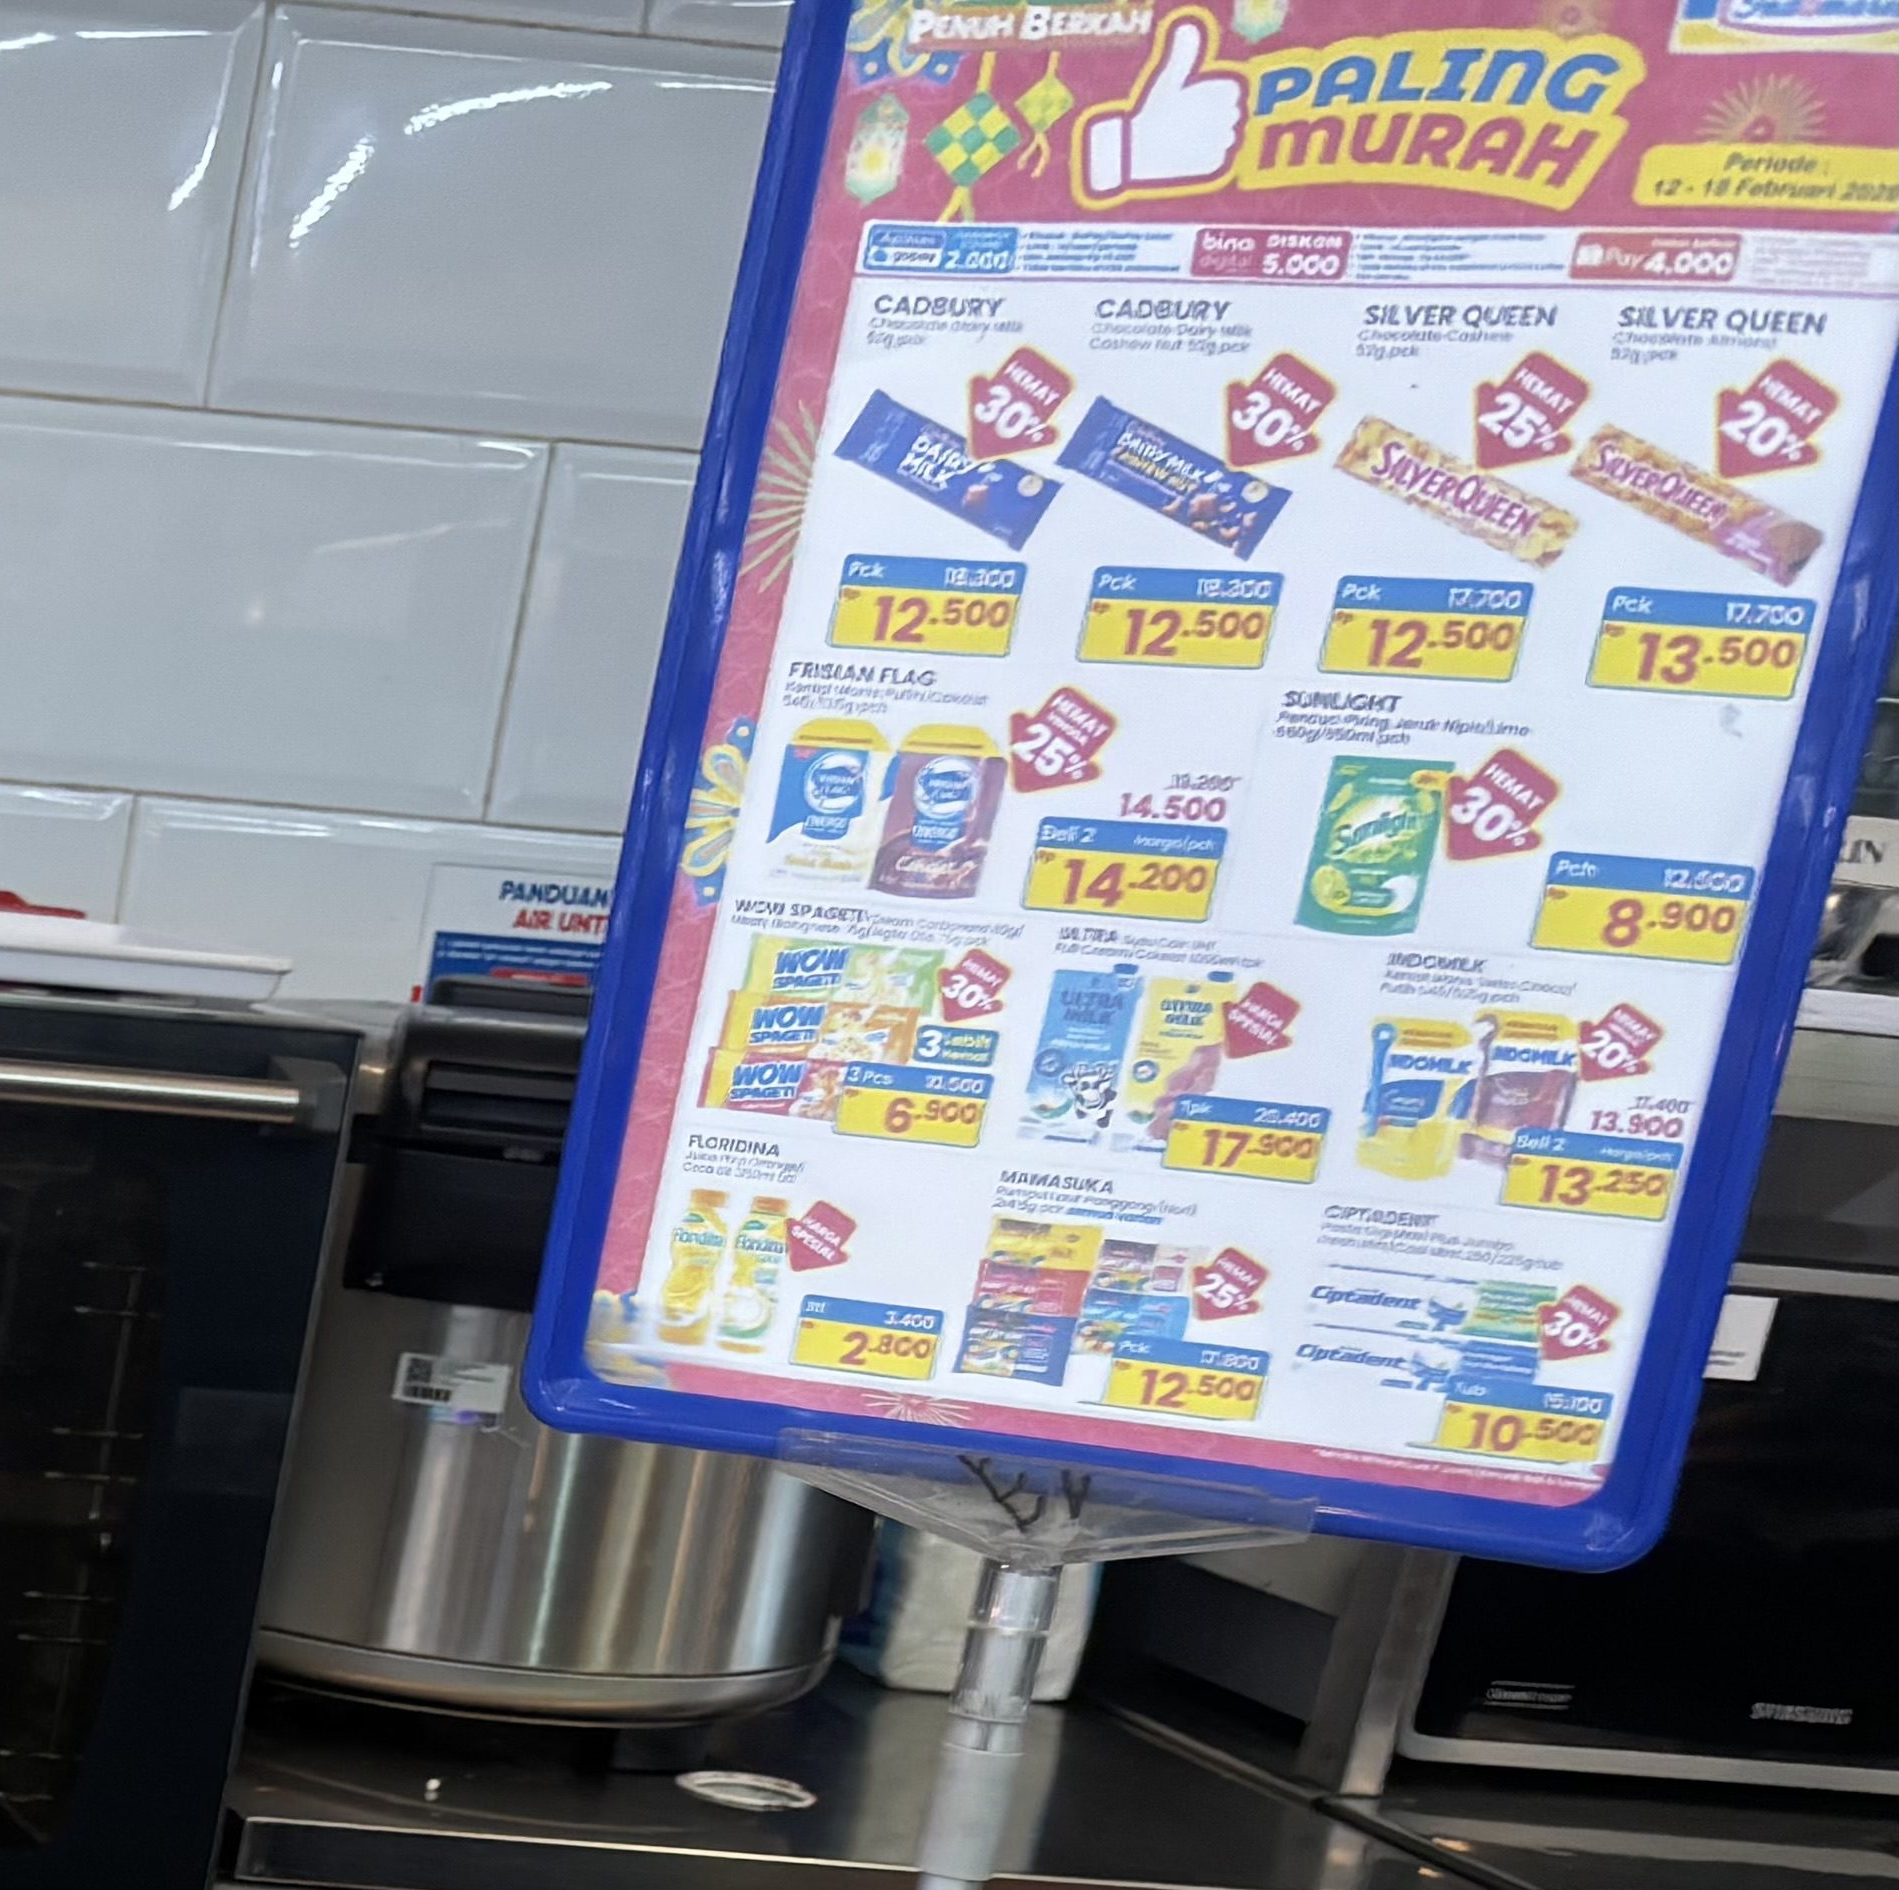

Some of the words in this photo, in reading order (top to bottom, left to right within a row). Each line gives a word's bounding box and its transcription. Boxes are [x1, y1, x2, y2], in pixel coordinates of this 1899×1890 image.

[908, 9, 1013, 42] PENUH
[1020, 6, 1153, 40] BERKAH
[1254, 47, 1622, 116] PALING
[1258, 112, 1601, 188] MURAH
[1262, 255, 1340, 275] 5.000
[1643, 251, 1734, 275] 4.000
[874, 295, 1005, 317] CADBURY
[1097, 299, 1231, 320] CADBURY
[1364, 305, 1456, 326] SILVER
[1463, 305, 1558, 328] QUEEN
[1618, 306, 1718, 330] SILVER
[1726, 309, 1828, 335] QUEEN
[1004, 361, 1060, 406] HEMAT
[1262, 368, 1322, 414] HEMAT
[1513, 367, 1574, 414] HEMAT
[1758, 375, 1822, 425] HEMAT
[974, 385, 1047, 443] 30%
[1232, 391, 1308, 452] 30%
[1478, 392, 1560, 452] 25%
[1721, 400, 1806, 463] 20%
[848, 560, 886, 579] Pck
[1098, 573, 1137, 592] Pck
[1343, 582, 1382, 601] Pck
[1613, 595, 1652, 615] Pck
[873, 595, 1010, 644] 12.500
[1124, 609, 1265, 657] 12.500
[1367, 618, 1515, 669] 12.500
[1636, 632, 1798, 685] 13.500
[879, 667, 937, 686] FLAG
[1052, 695, 1110, 738] HEMAT
[1011, 723, 1088, 781] 25%
[1483, 763, 1544, 814] HEMAT
[1119, 793, 1227, 823] 14.500
[1450, 787, 1529, 848] 30%
[1080, 827, 1097, 843] 2
[1063, 858, 1208, 908] 14.200
[513, 909, 552, 930] AIR
[734, 899, 786, 916] WOW
[1601, 898, 1737, 948] 8.900
[776, 948, 850, 975] WOW
[944, 975, 994, 1012] 30%
[753, 1005, 826, 1030] WOW
[917, 1031, 944, 1058] 3
[1582, 1030, 1638, 1075] 20%
[733, 1063, 803, 1086] WOW
[847, 1066, 860, 1082] 3
[885, 1097, 976, 1134] 6.900
[1591, 1110, 1684, 1138] 13.900
[688, 1134, 780, 1157] FLORIDINA
[1203, 1129, 1315, 1168] 17.900
[1552, 1138, 1566, 1151] 2
[999, 1171, 1114, 1194] MAMASUKA
[1539, 1165, 1667, 1206] 13.250
[791, 1225, 837, 1262] SPESIAL
[804, 1217, 842, 1247] HARGA
[1195, 1273, 1249, 1312] 25%
[1310, 1285, 1422, 1311] Ciptadent
[839, 1331, 930, 1366] 2.800
[1544, 1311, 1601, 1351] 30%
[1295, 1344, 1406, 1369] Ciptadent
[1141, 1369, 1257, 1409] 12.500
[1468, 1412, 1597, 1451] 10.500
